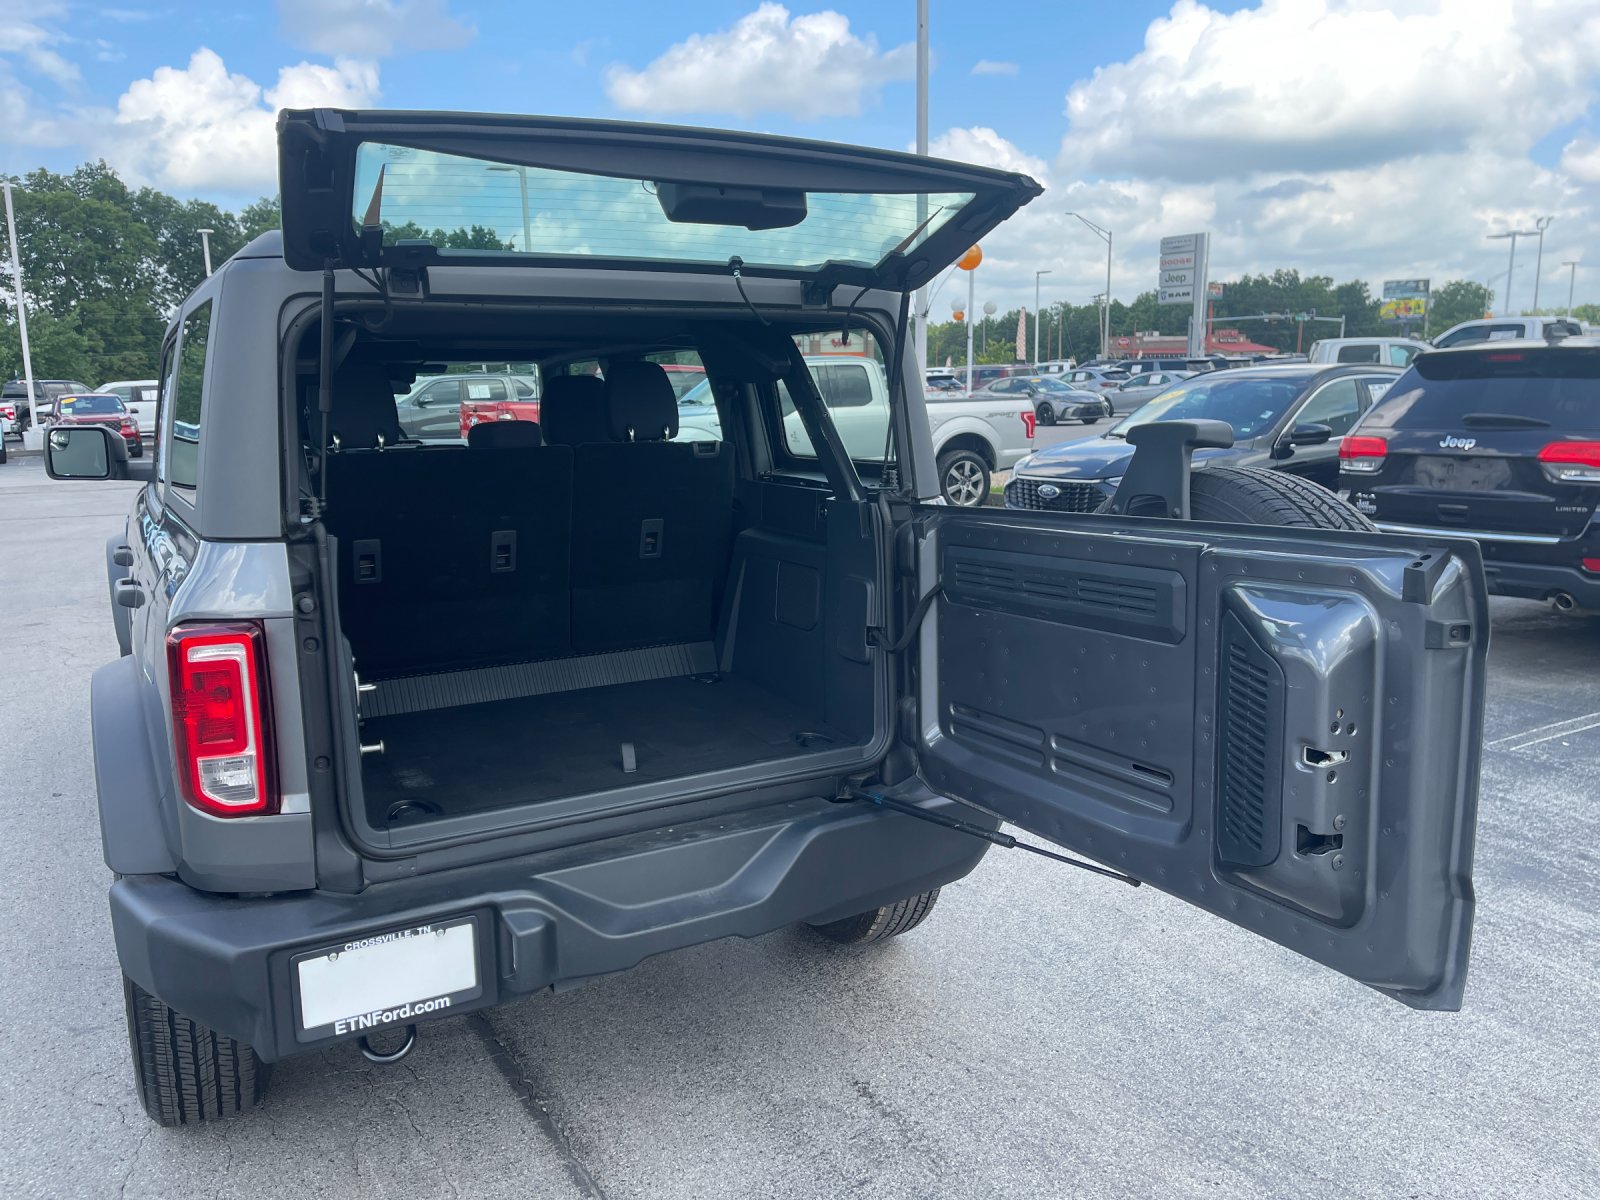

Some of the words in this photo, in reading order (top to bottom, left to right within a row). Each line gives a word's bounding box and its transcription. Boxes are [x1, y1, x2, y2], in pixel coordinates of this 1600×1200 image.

[1164, 273, 1186, 284] Jeep
[1439, 435, 1476, 451] Jeep
[344, 930, 414, 952] CROSSVILLE,
[416, 925, 431, 936] TN
[334, 996, 450, 1036] ETNFord.com
